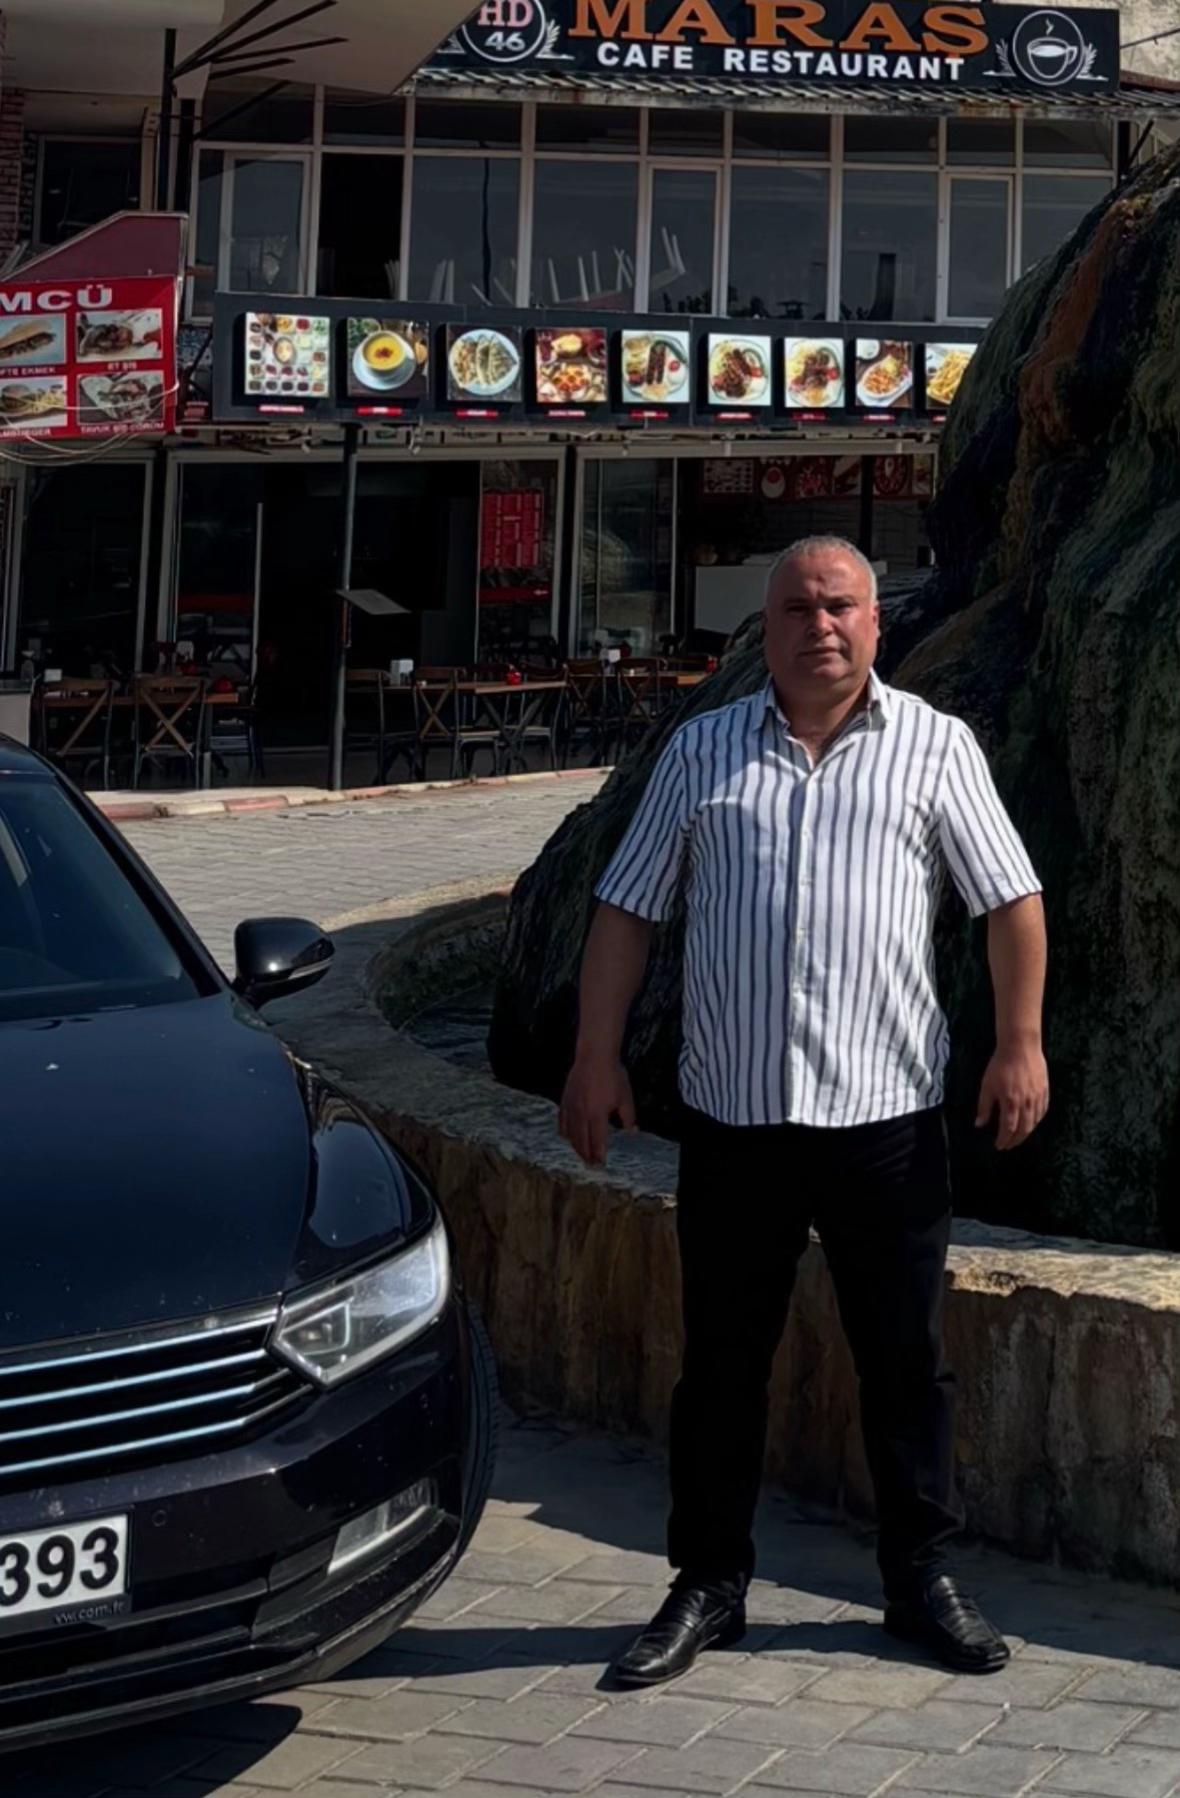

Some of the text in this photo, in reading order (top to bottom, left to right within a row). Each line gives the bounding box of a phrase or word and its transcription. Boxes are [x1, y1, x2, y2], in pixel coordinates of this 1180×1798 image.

[478, 0, 534, 27] HD
[484, 31, 526, 51] 46
[597, 42, 964, 80] CAFE RESTAURANT
[0, 1526, 119, 1607] 393
